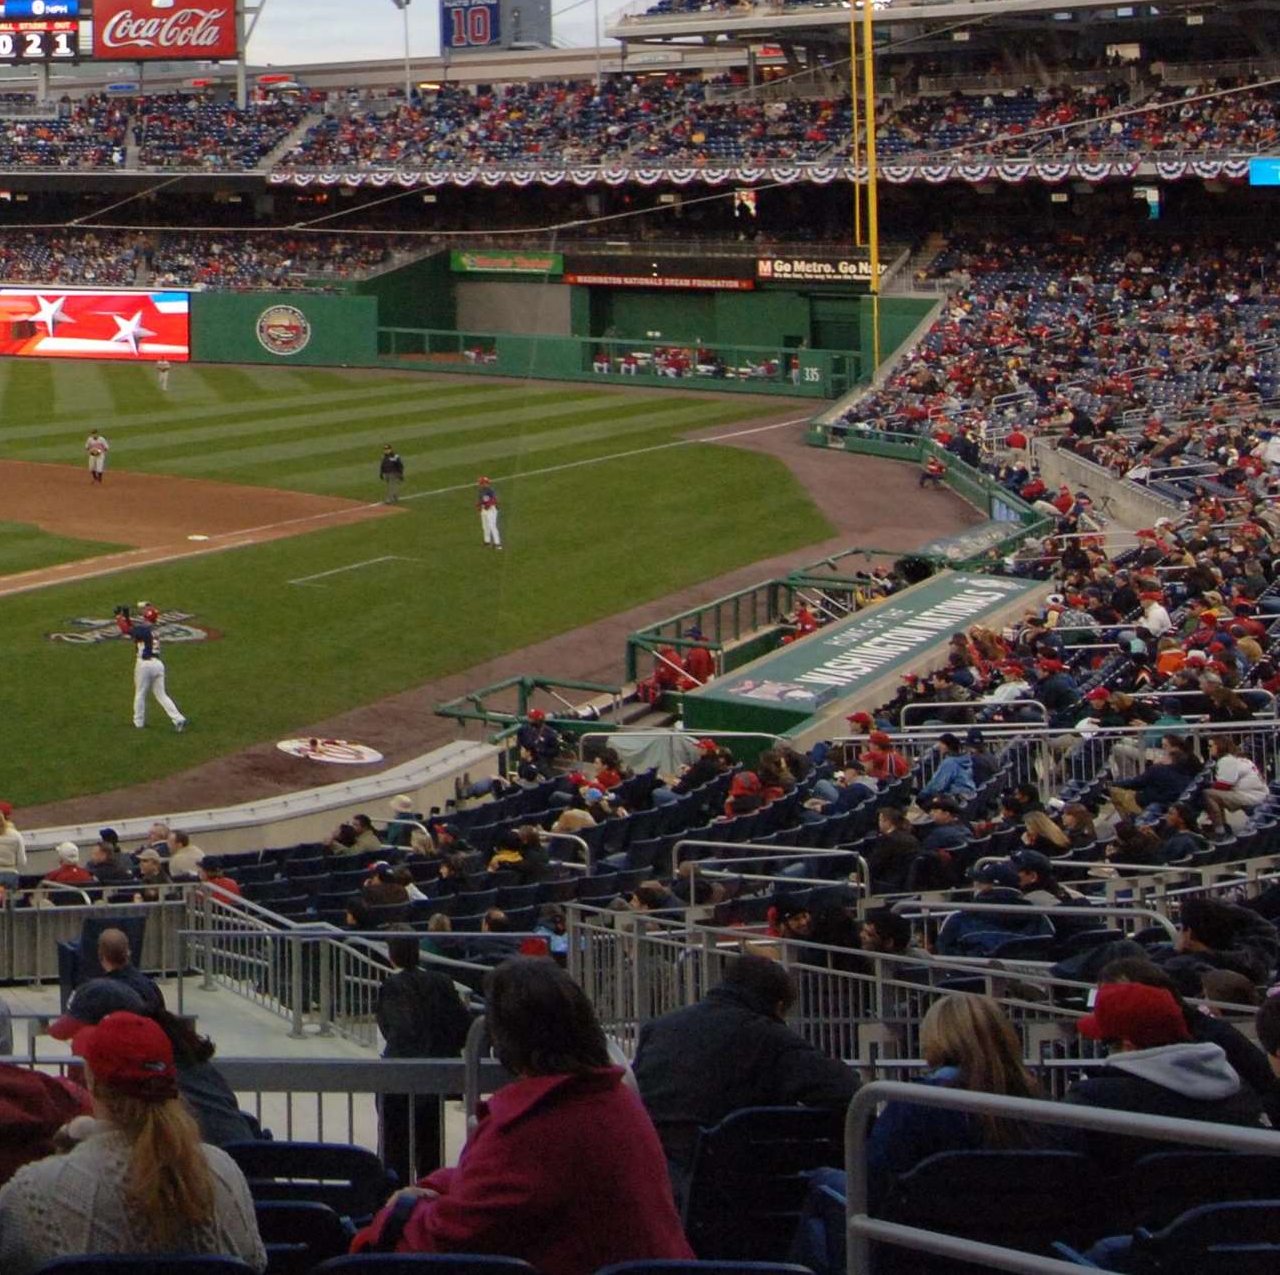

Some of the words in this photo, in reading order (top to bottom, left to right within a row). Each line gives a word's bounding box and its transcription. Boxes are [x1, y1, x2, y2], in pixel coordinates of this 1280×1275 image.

[45, 5, 68, 14] MPH
[444, 0, 469, 8] NATS
[103, 8, 226, 47] Coca-Cola
[451, 6, 490, 46] 10
[25, 34, 42, 55] 2
[55, 33, 71, 54] 1
[774, 260, 791, 273] Go
[793, 260, 835, 274] Metro.
[838, 261, 856, 274] Go
[577, 276, 622, 284] WASHINGTON
[624, 277, 663, 285] NATIONALS
[664, 278, 690, 287] DREAM
[692, 279, 739, 288] FOUNDATION
[804, 367, 820, 381] 335
[794, 626, 938, 685] WASHINGTON
[904, 589, 1006, 630] NATIONALS
